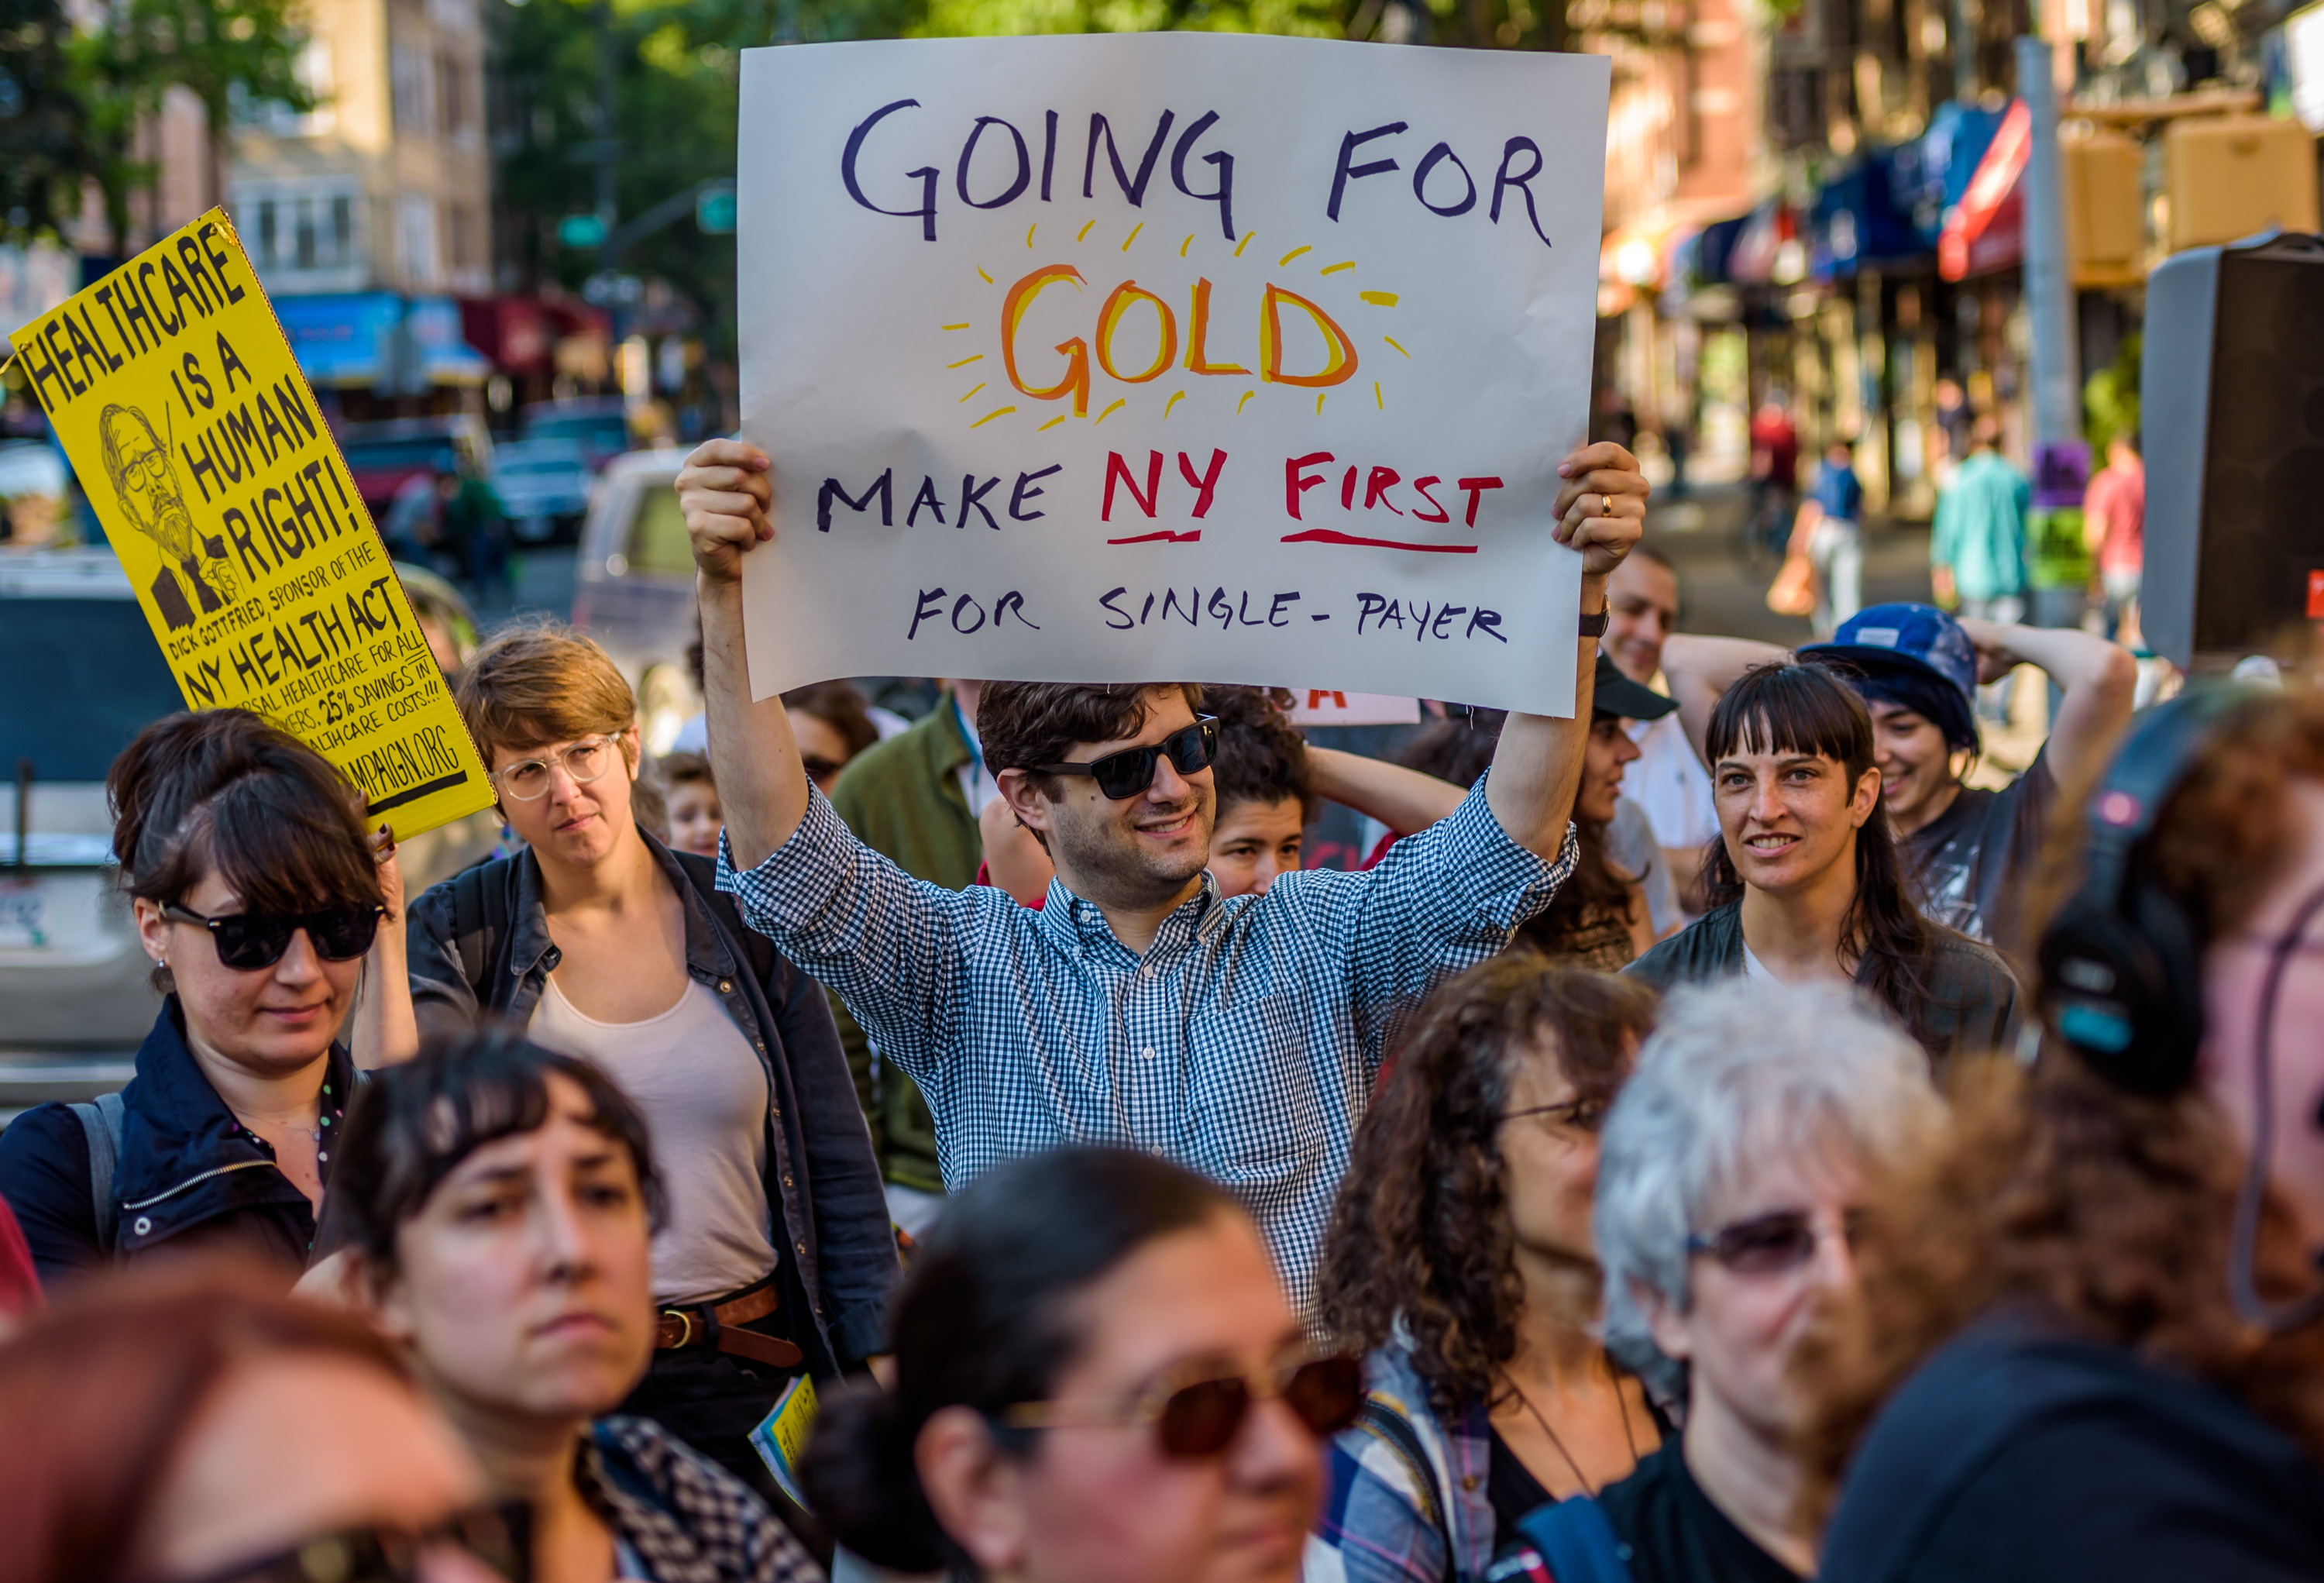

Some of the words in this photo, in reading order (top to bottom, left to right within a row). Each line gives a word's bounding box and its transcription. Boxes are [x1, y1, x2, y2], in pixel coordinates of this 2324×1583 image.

[841, 99, 1235, 241] GOING
[1327, 122, 1551, 247] FOR
[22, 223, 246, 415] HEALTHCARE
[170, 352, 215, 418] IS
[217, 330, 252, 394] A
[999, 265, 1359, 417] GOLD
[180, 374, 318, 504] HUMAN
[816, 464, 1062, 533] MAKE
[1102, 448, 1227, 521] NY
[1286, 452, 1504, 528] FIRST
[222, 455, 359, 583] RIGHT!
[168, 634, 199, 660] DICK
[199, 597, 271, 646] GOTTFRIED,
[268, 566, 331, 611] SPONSOR
[330, 555, 348, 580] OF
[345, 541, 376, 571] THE
[184, 655, 227, 708] NY
[229, 603, 351, 694] HEALTH
[346, 576, 401, 644] ACT
[907, 587, 1040, 640] FOR
[280, 652, 367, 707] HEALTHCARE
[369, 640, 397, 668] FOR
[397, 630, 424, 657] ALL
[310, 711, 383, 752] ALTHCARE
[387, 680, 440, 721] COSTS!!!
[318, 690, 355, 725] 25%
[353, 666, 414, 709] SAVINGS
[416, 659, 431, 680] IN
